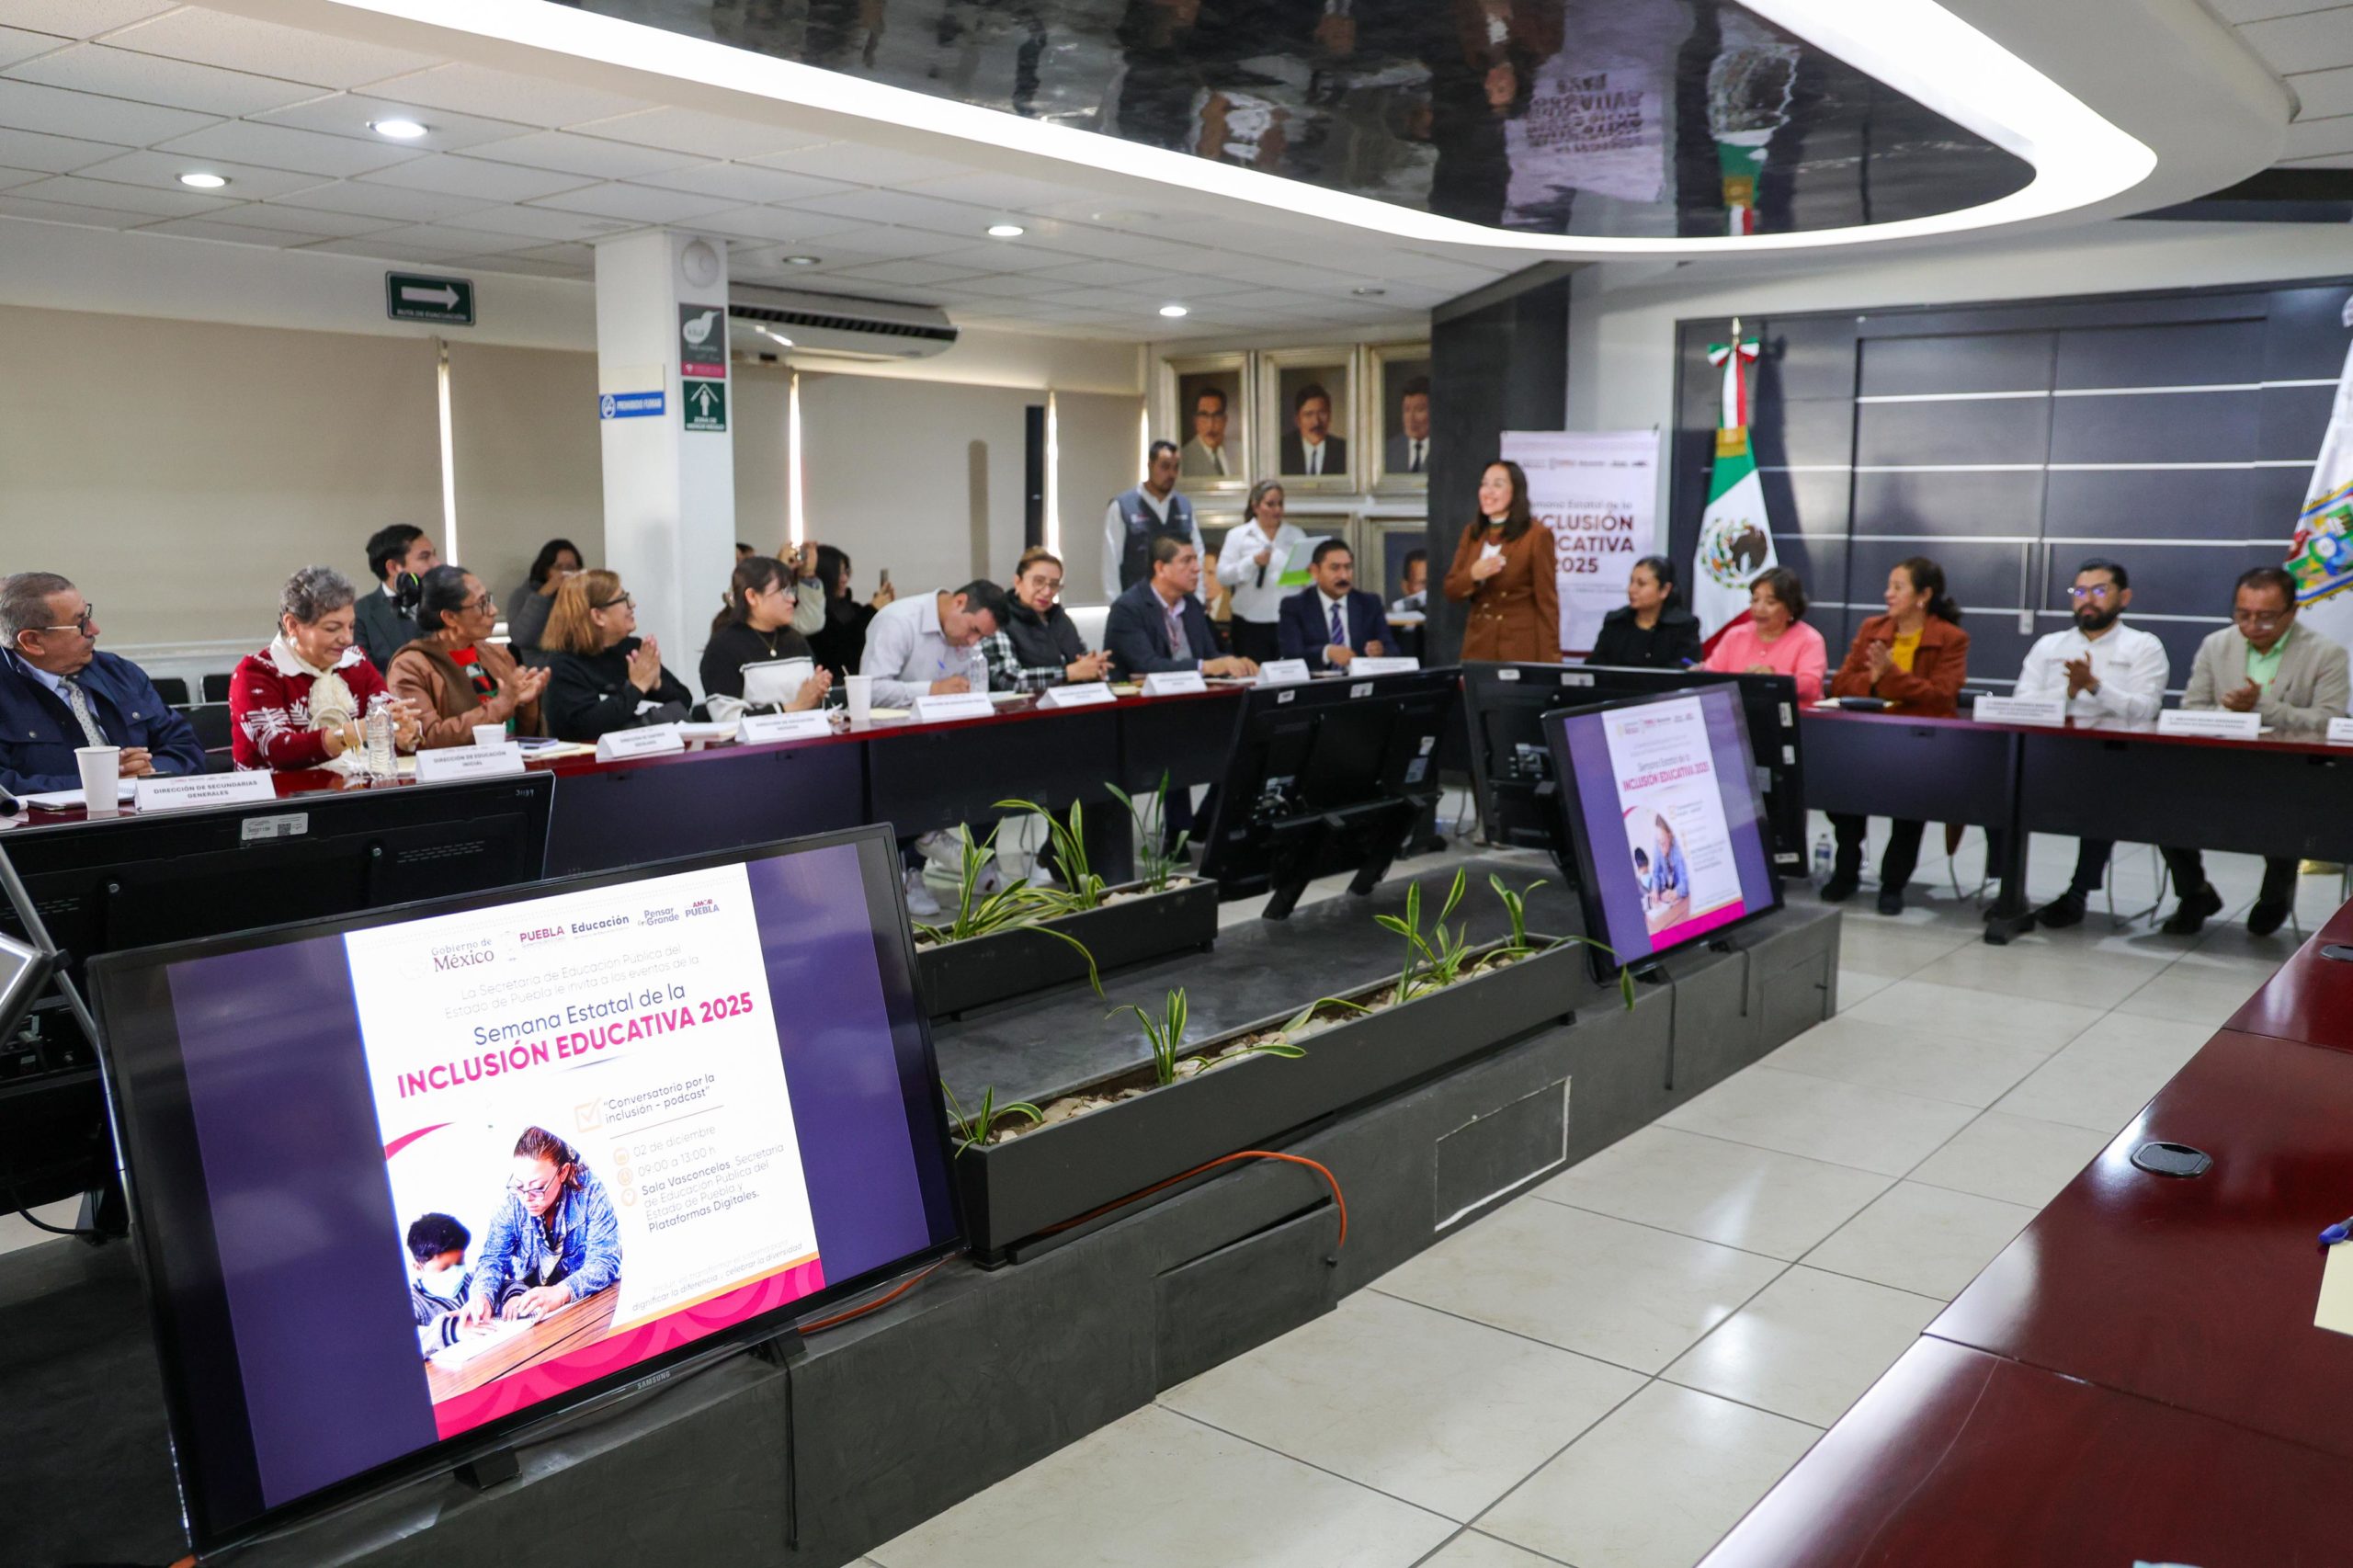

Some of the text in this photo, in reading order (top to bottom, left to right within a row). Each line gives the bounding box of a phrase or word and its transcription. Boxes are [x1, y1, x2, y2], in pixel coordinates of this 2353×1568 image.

[1539, 511, 1634, 530] CLUSIÓN
[1555, 536, 1634, 552] CATIVA
[1555, 557, 1598, 574] 025
[153, 784, 195, 794] DIRECCIÓN
[207, 779, 258, 790] SECUNDARIAS
[187, 790, 230, 799] GENERALES
[644, 907, 674, 919] Pensar
[646, 913, 679, 926] Grande
[685, 904, 720, 917] PUEBLA
[519, 926, 565, 943] PUEBLA
[571, 915, 630, 934] Educación
[431, 937, 493, 956] Gobierno de
[433, 949, 494, 972] México
[462, 989, 476, 1000] La
[544, 971, 560, 983] de
[665, 943, 681, 957] del
[445, 954, 699, 1019] Estado de Puebla le invita a los eventos de la
[472, 982, 687, 1047] Semana Estatal de la
[397, 991, 754, 1098] INCLUSIÓN EDUCATIVA 2025
[686, 1077, 703, 1091] por
[705, 1074, 715, 1084] la
[605, 1102, 654, 1124] inclusión
[633, 1126, 715, 1157] 02 de diciembre
[638, 1159, 668, 1177] 09:00
[671, 1158, 678, 1167] a
[680, 1147, 707, 1163] 13:00
[641, 1180, 665, 1196] Sala
[643, 1198, 658, 1209] de
[753, 1159, 769, 1173] del
[646, 1202, 682, 1221] Estado
[684, 1196, 699, 1208] de
[699, 1185, 735, 1201] Puebla
[648, 1190, 760, 1233] Plataformas Digitales.
[631, 1292, 670, 1312] dignificar
[671, 1288, 678, 1297] la
[680, 1274, 718, 1293] diferencia
[725, 1259, 756, 1277] celebrar
[766, 1241, 802, 1262] diversidad
[636, 1370, 671, 1391] SAMSUNG
